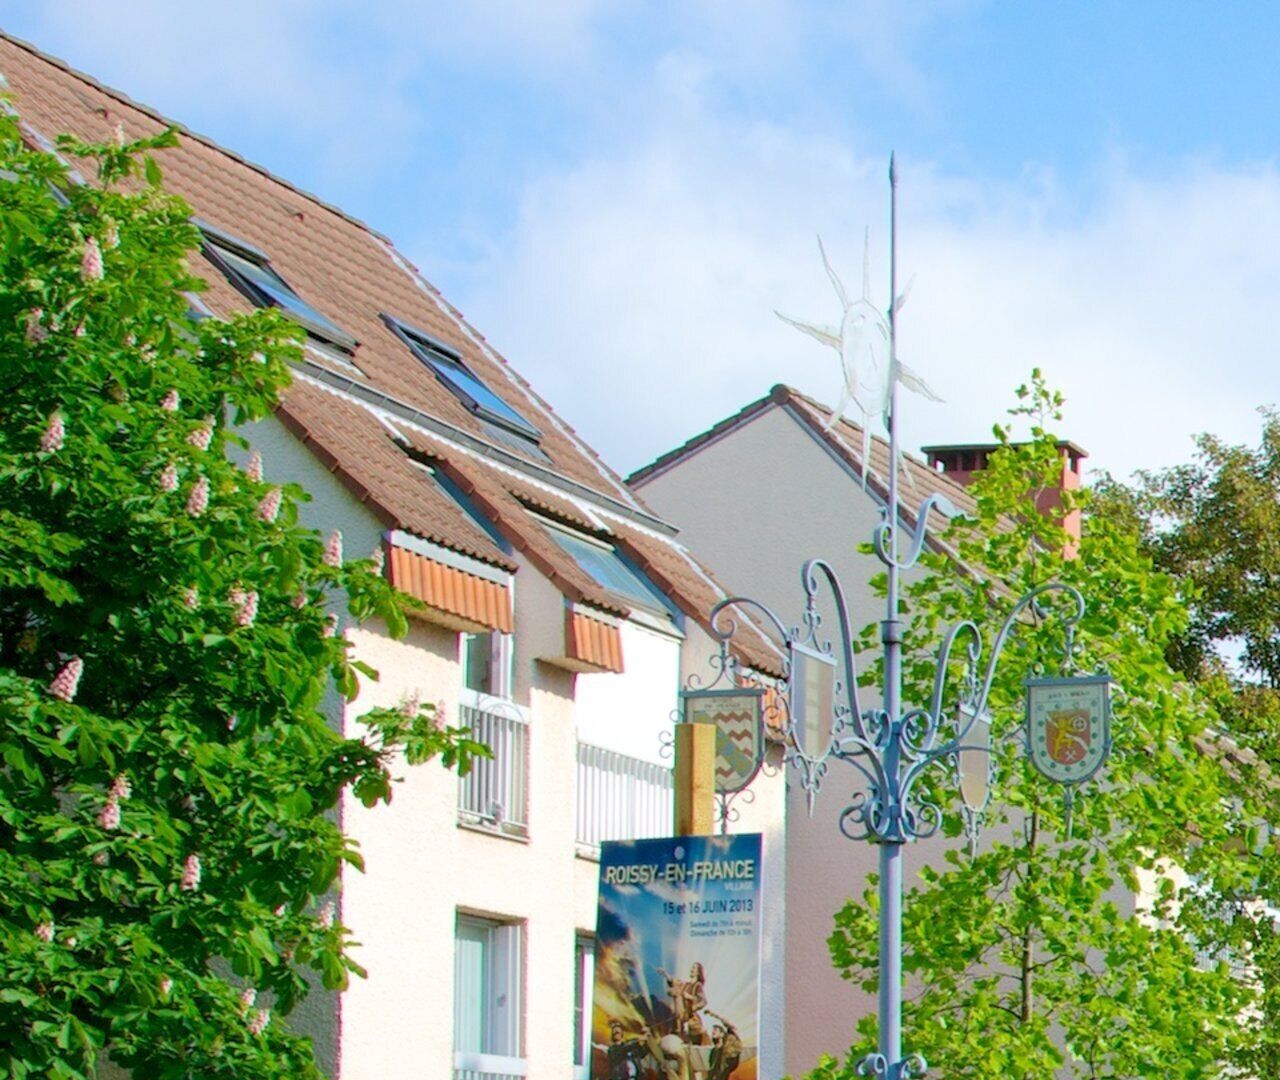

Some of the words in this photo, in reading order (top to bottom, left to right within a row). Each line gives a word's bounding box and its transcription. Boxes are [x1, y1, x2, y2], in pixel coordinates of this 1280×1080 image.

[605, 859, 754, 885] ROISSY-EN-FRANCE
[663, 902, 674, 915] 15
[676, 903, 686, 914] et
[689, 901, 700, 914] 16
[702, 900, 727, 914] JUIN
[729, 899, 753, 913] 2013
